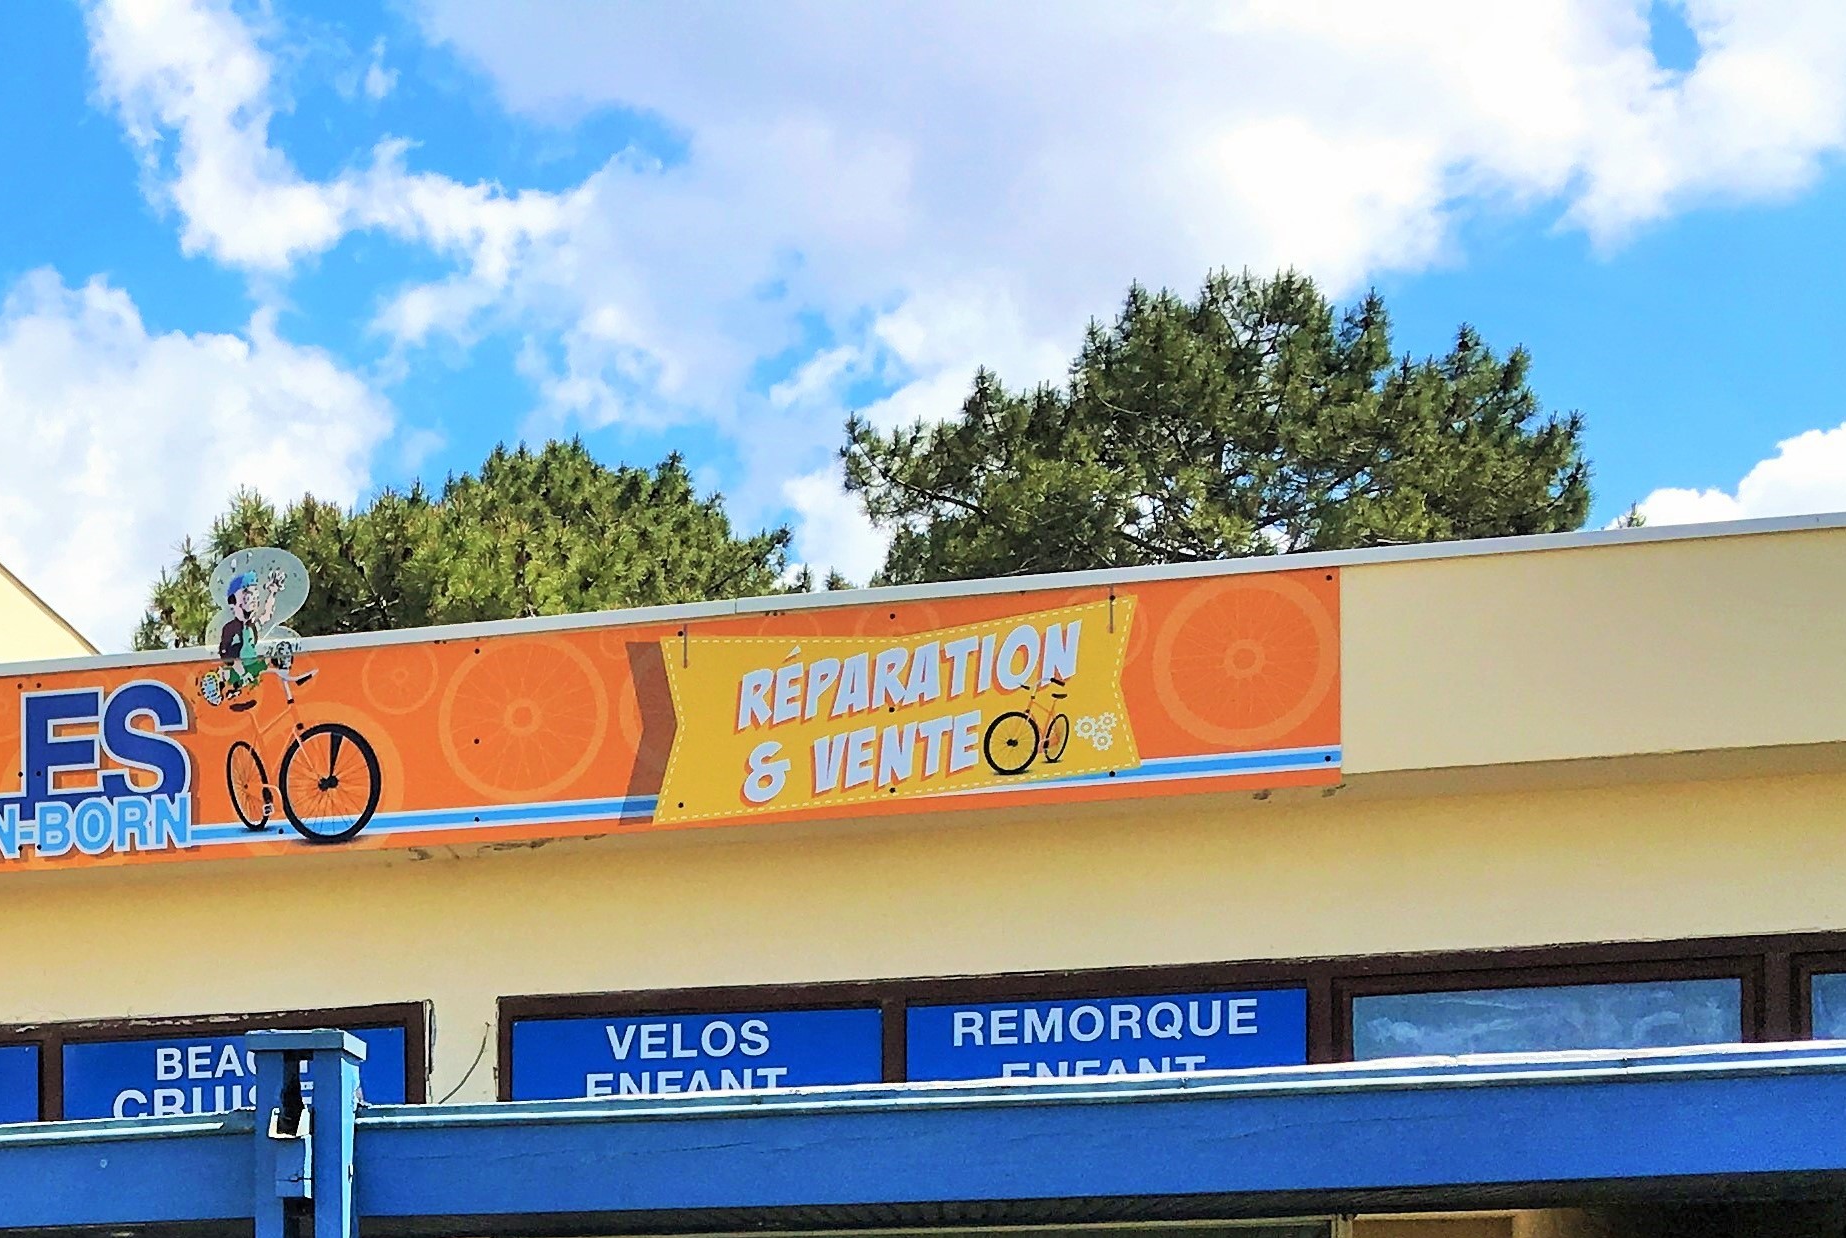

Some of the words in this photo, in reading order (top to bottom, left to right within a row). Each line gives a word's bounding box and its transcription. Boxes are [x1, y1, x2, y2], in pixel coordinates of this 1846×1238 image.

[737, 621, 1083, 730] RÉPARATION
[743, 741, 790, 802] &
[813, 710, 981, 794] VENTE
[606, 1020, 770, 1060] VELOS
[953, 998, 1258, 1047] REMORQUE
